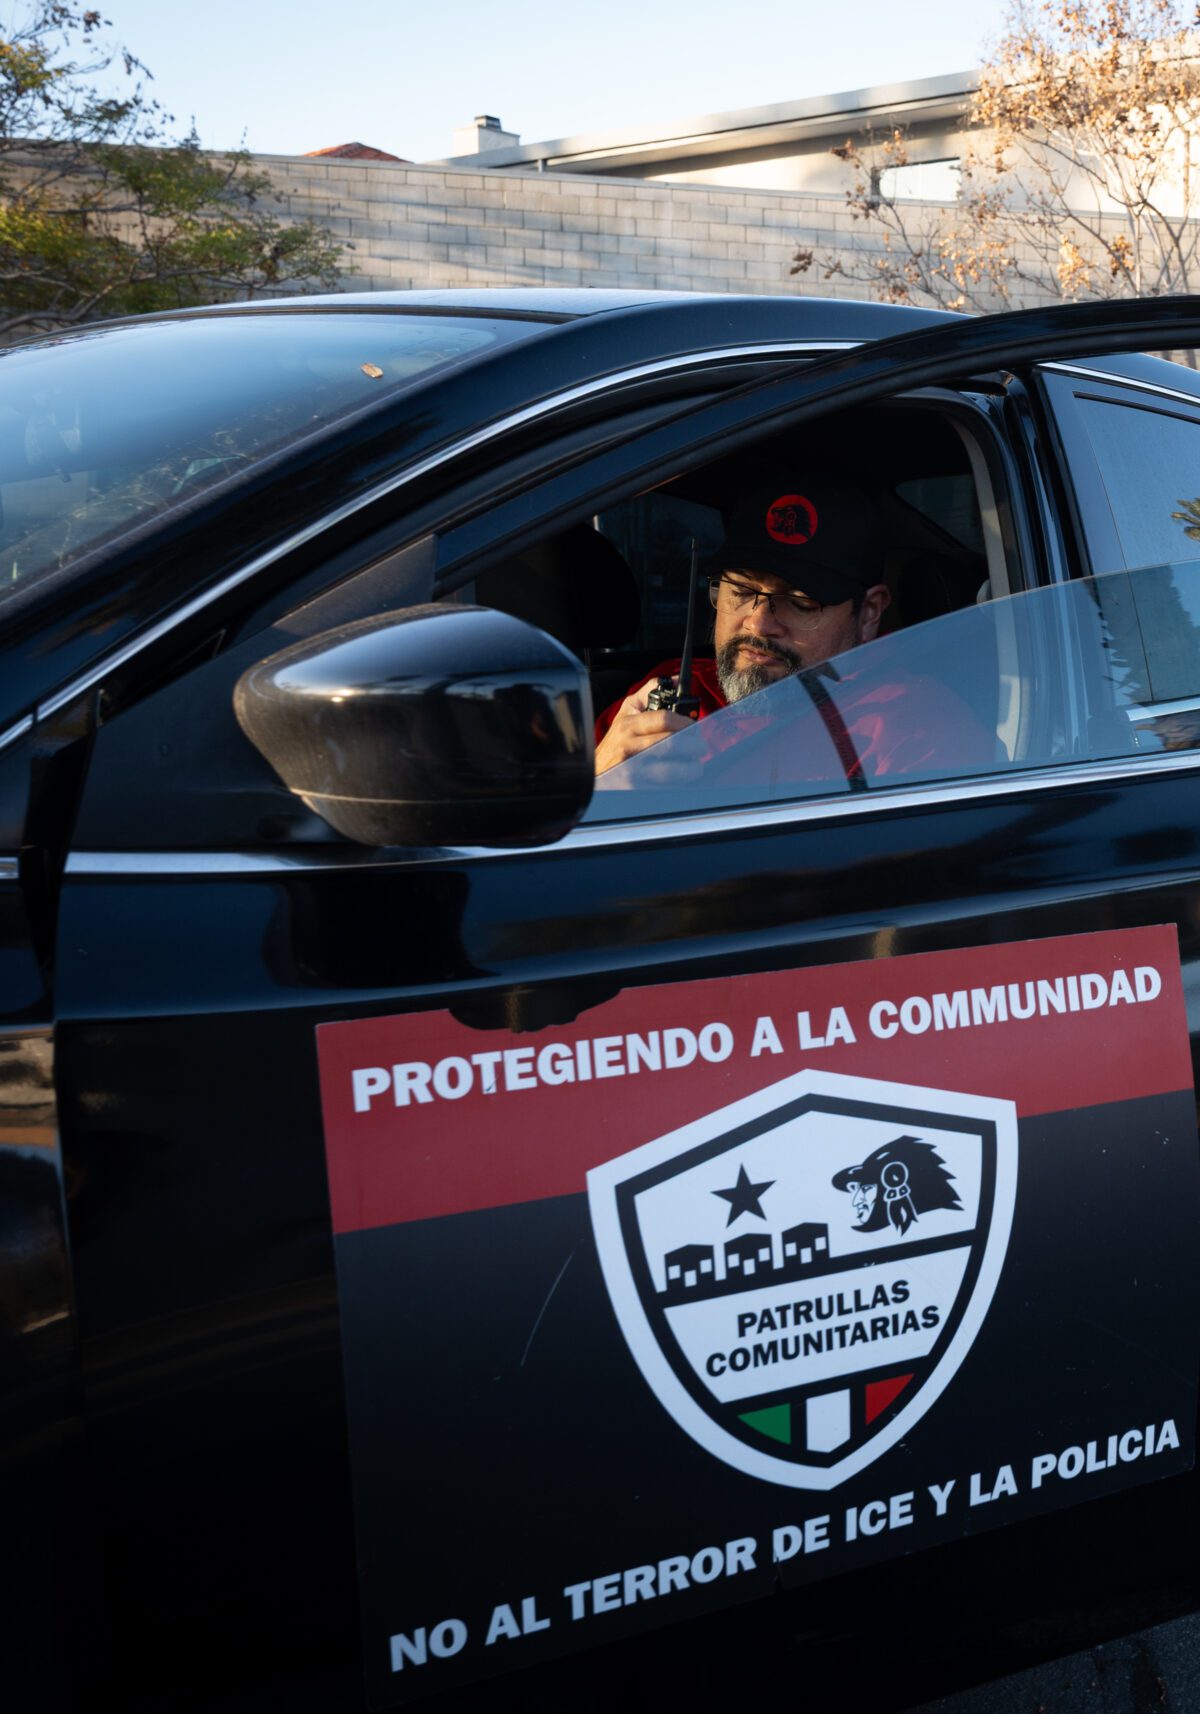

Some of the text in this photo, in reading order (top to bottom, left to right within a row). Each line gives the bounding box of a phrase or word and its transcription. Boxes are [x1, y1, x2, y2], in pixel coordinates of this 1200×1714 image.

[351, 965, 1162, 1113] PROTEGIENDO A LA COMMUNIDAD
[705, 1305, 940, 1378] COMUNITARIAS
[737, 1279, 910, 1338] PATRULLAS
[389, 1418, 1181, 1673] NO AL TERROR DE ICE Y LA POLICIA
